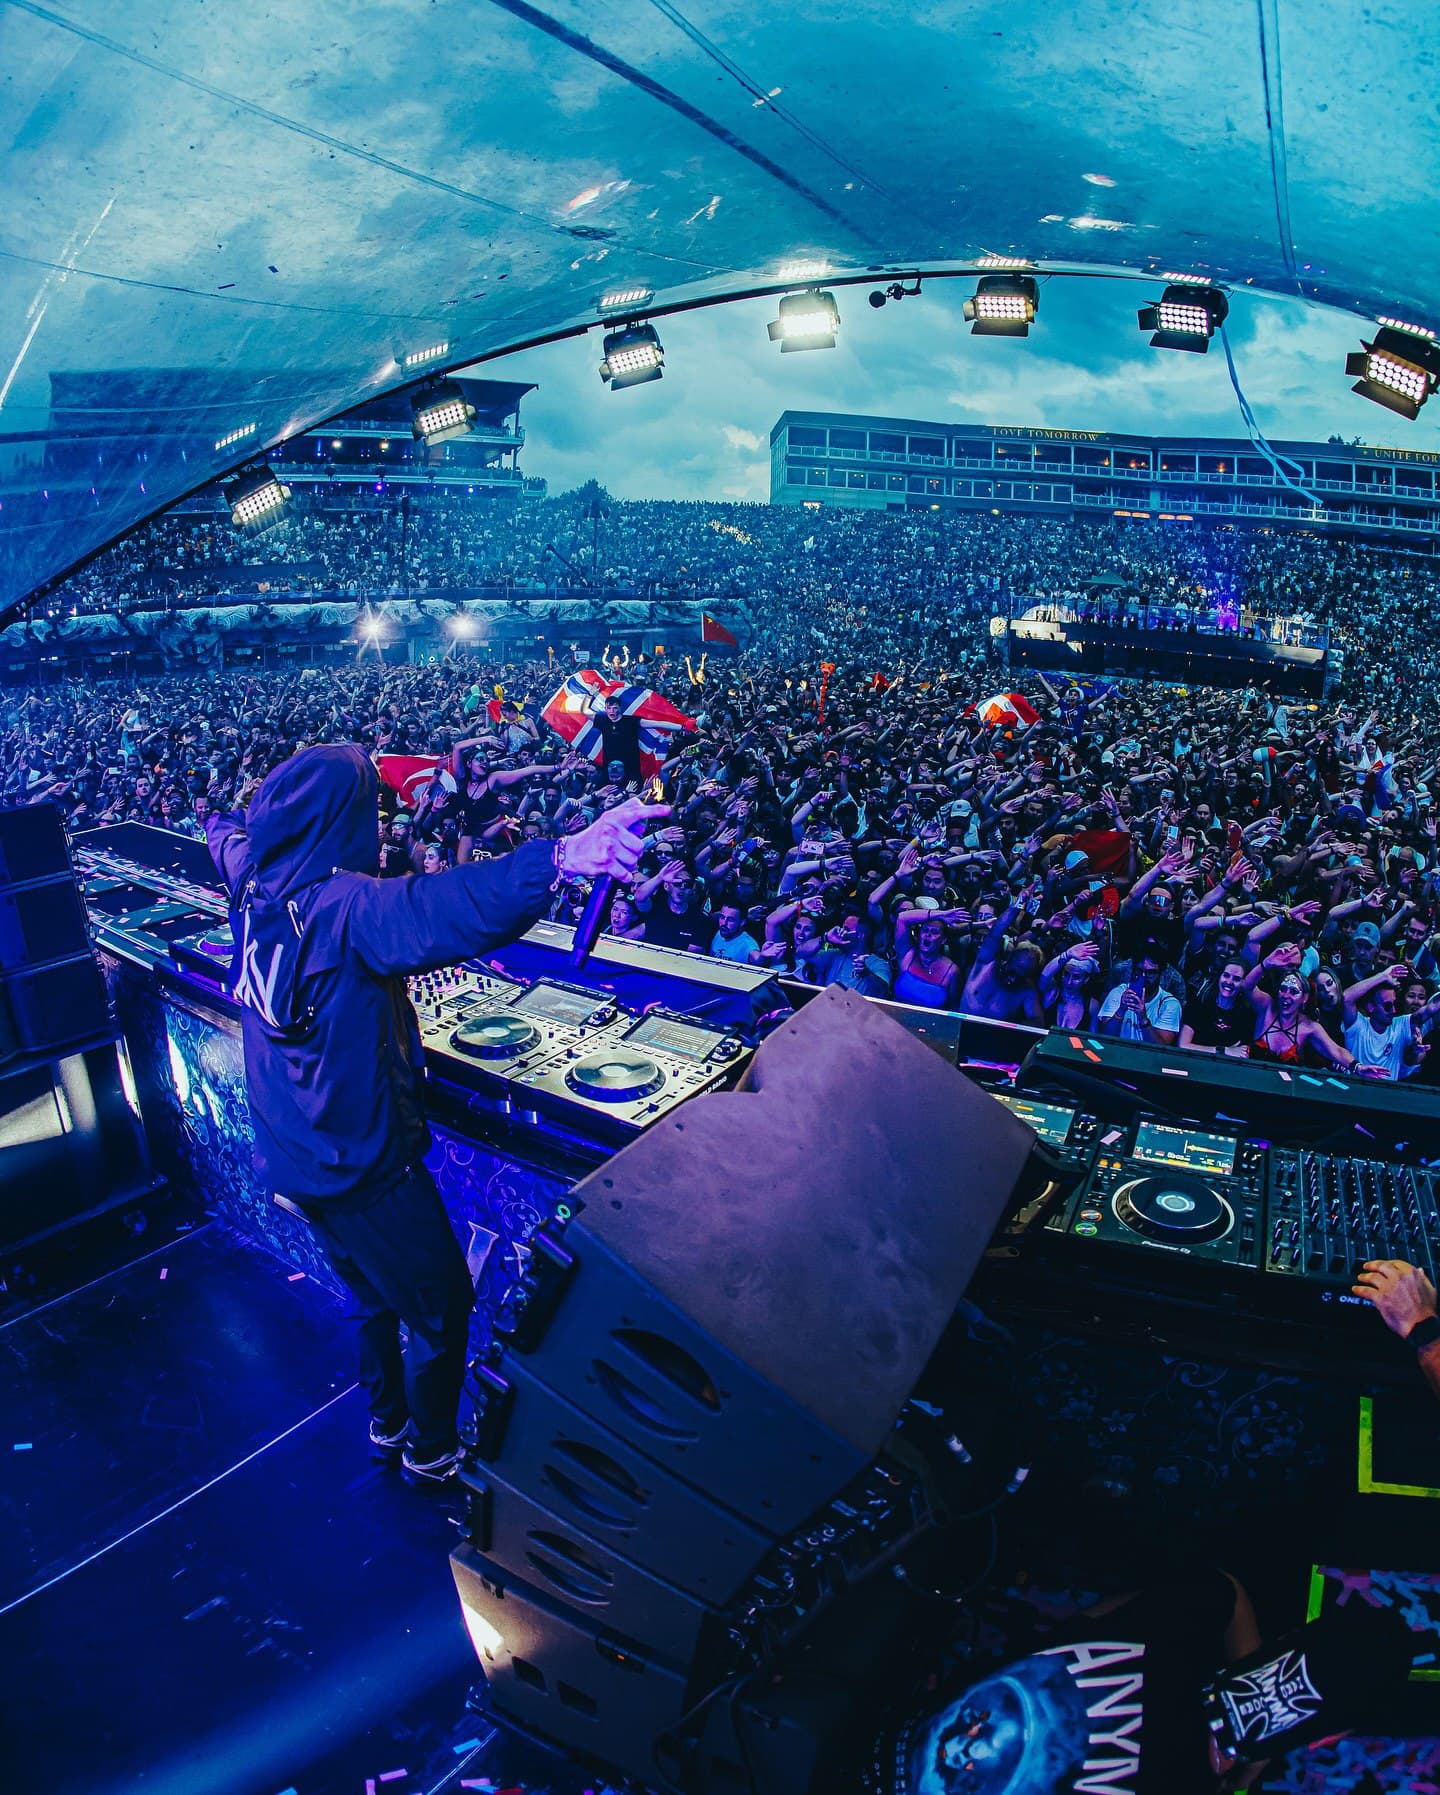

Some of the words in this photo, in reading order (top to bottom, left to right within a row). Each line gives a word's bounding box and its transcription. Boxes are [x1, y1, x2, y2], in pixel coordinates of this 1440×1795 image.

[992, 427, 1024, 437] LOVE
[1028, 429, 1099, 441] TOMORROW
[1375, 449, 1412, 460] UNITE
[1339, 1295, 1361, 1305] ONE
